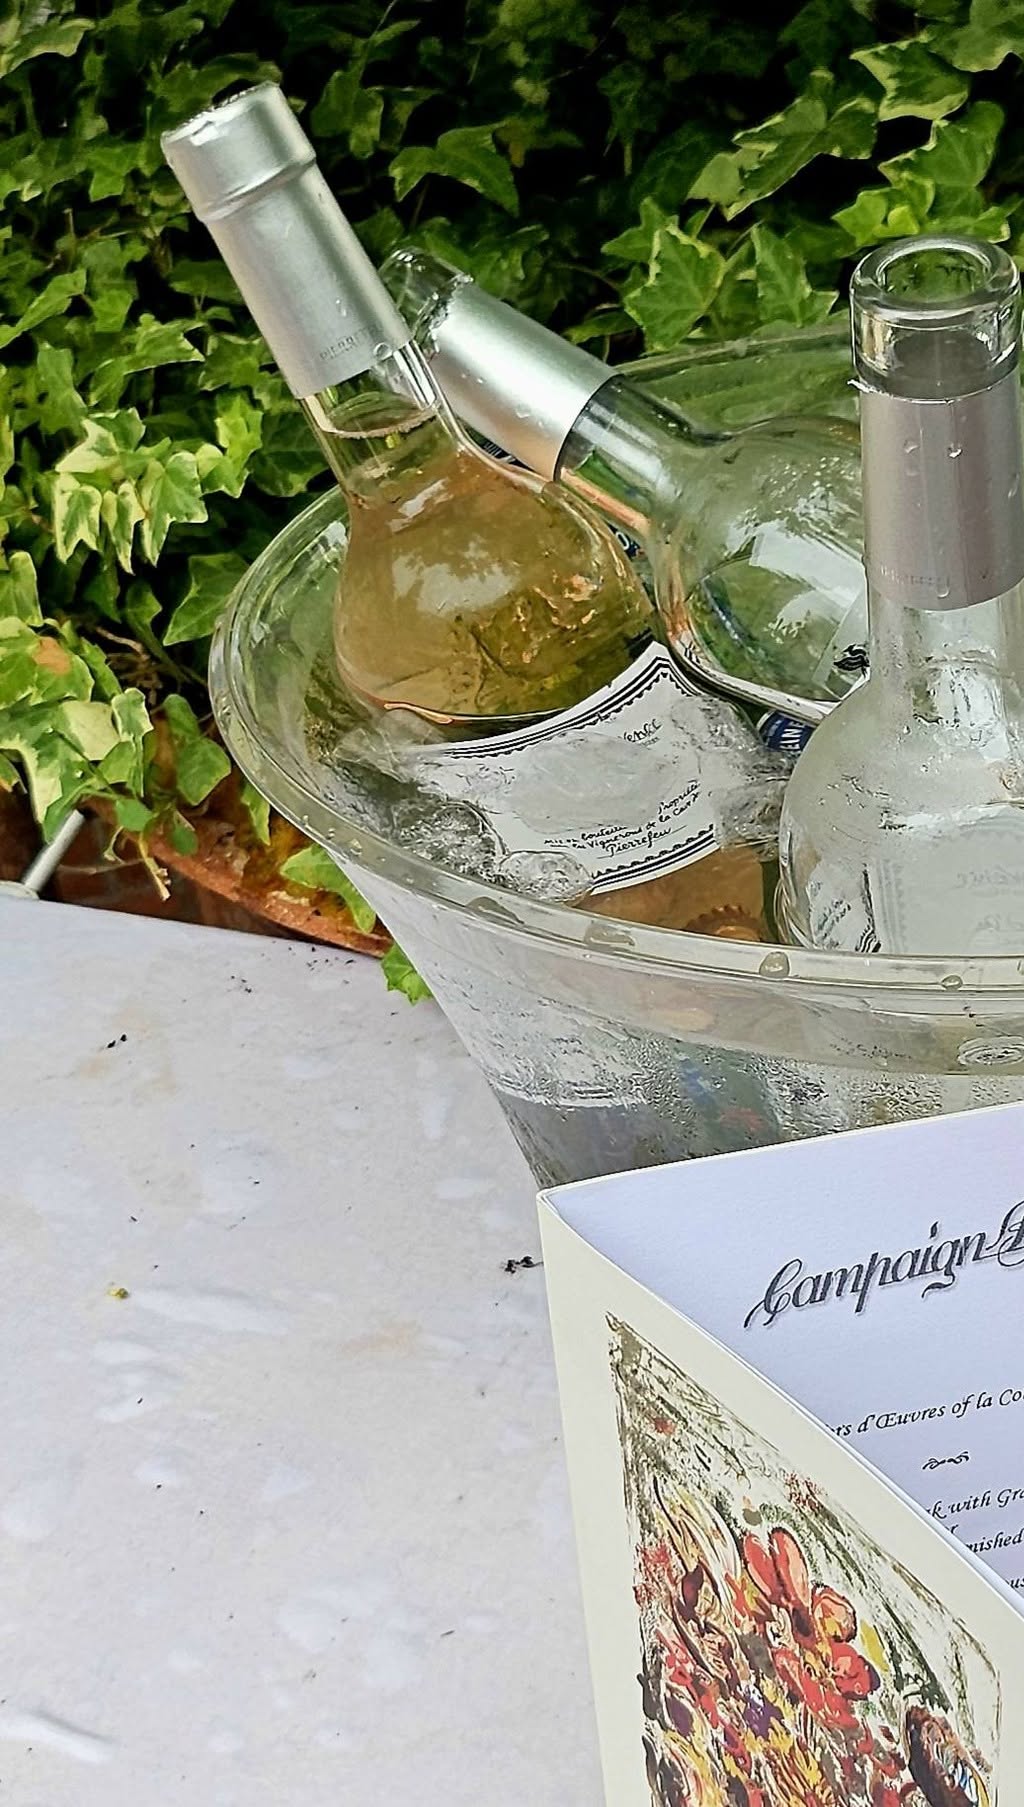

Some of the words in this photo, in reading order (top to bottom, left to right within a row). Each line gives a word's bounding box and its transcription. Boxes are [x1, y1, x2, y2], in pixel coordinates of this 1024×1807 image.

[743, 1220, 988, 1329] Campaign
[826, 1424, 852, 1437] rs
[950, 1393, 976, 1419] of
[976, 1391, 993, 1410] la
[949, 1490, 993, 1515] with
